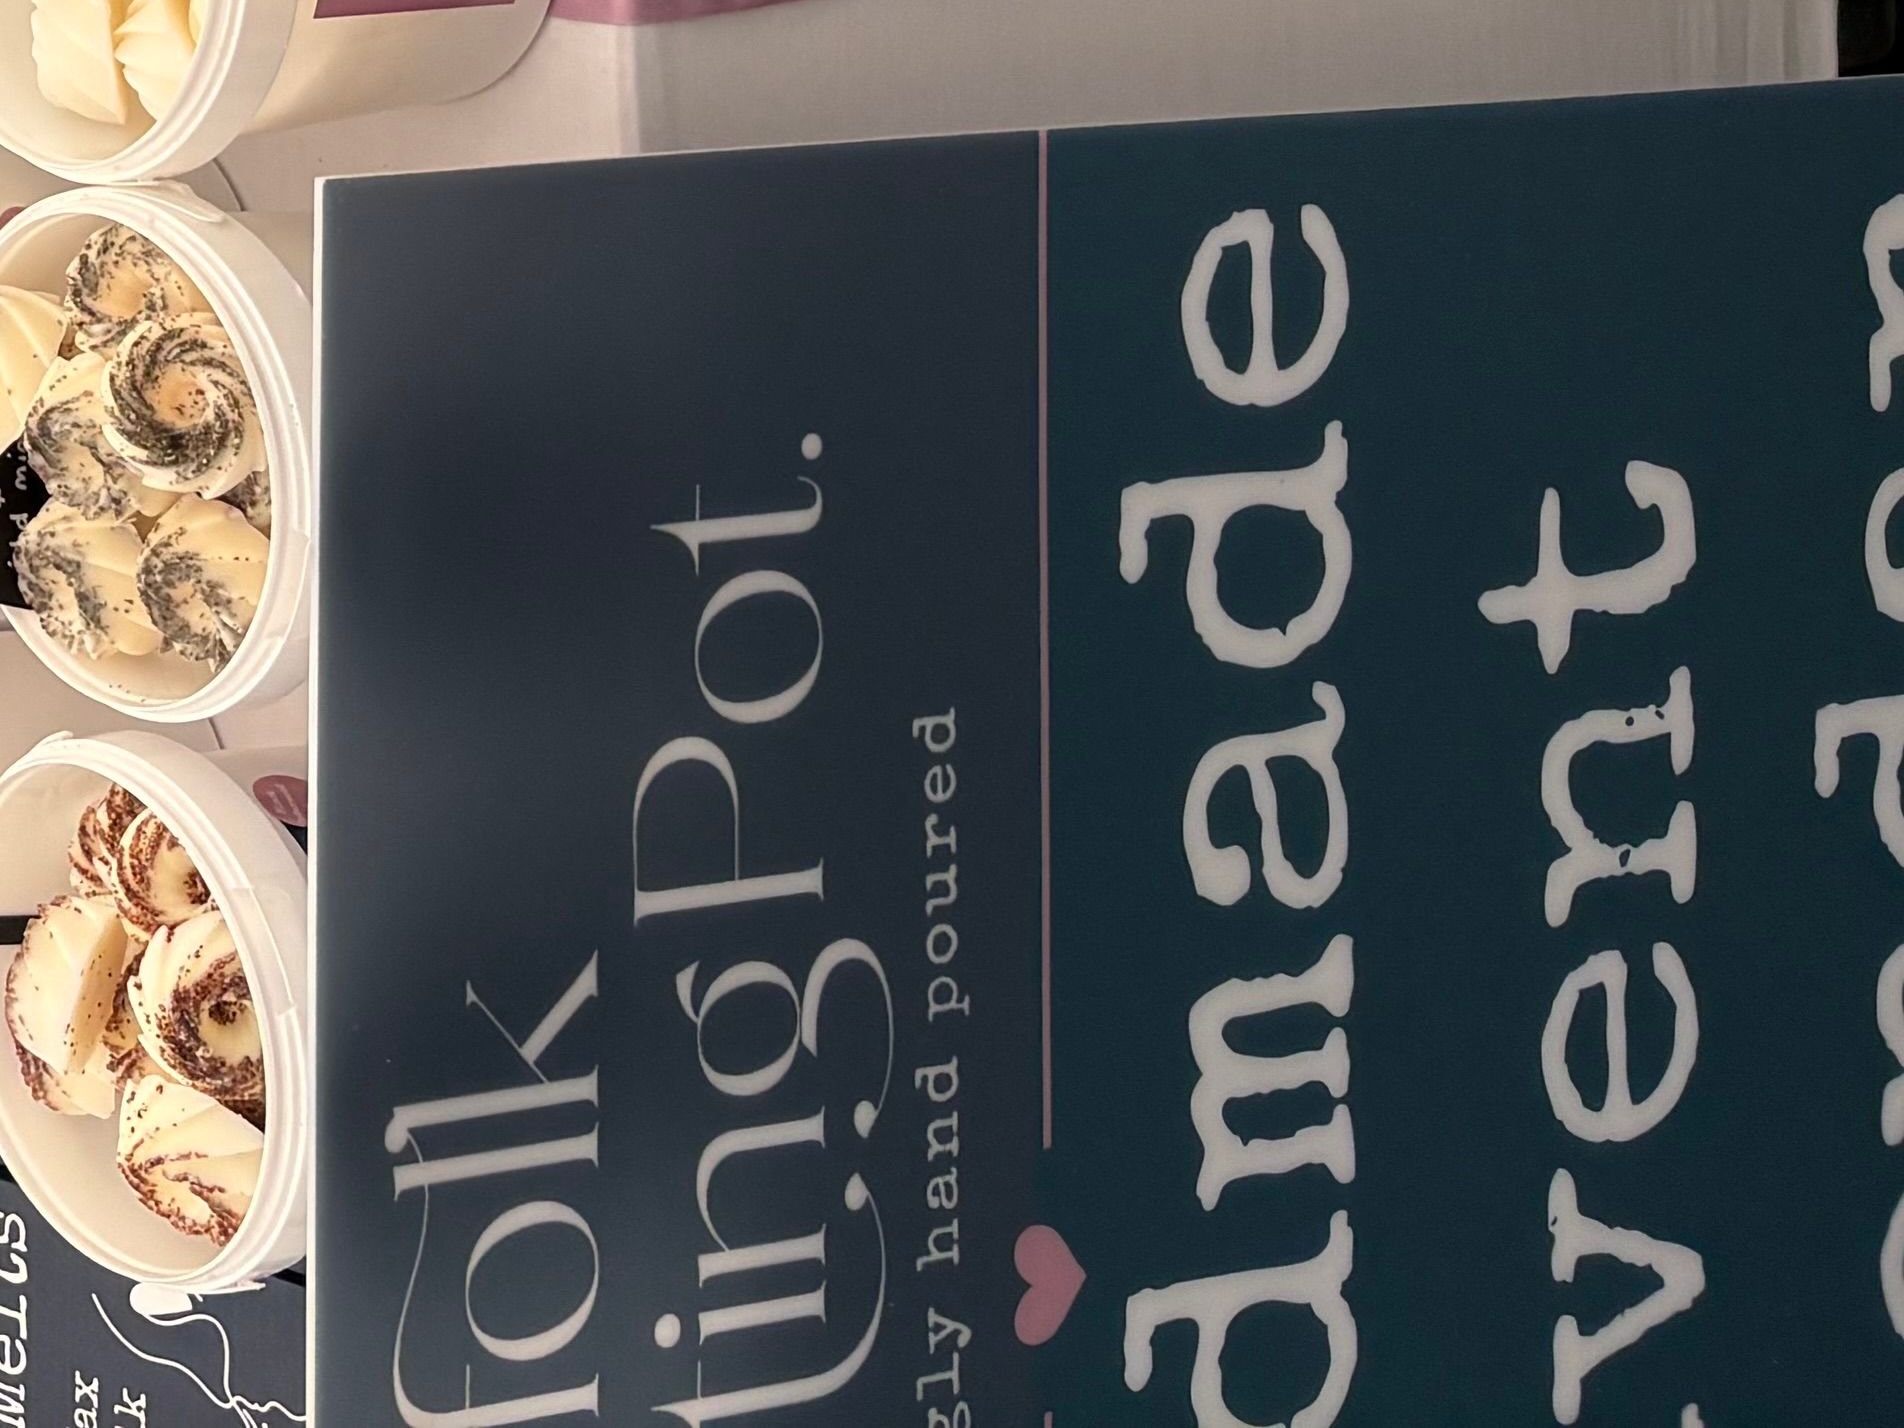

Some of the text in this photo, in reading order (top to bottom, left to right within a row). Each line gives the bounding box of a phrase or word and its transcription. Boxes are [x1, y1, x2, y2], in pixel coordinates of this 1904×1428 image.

[912, 705, 970, 1268] hand poured
[1118, 202, 1359, 1428] dmade
[1477, 458, 1707, 1428] vent
